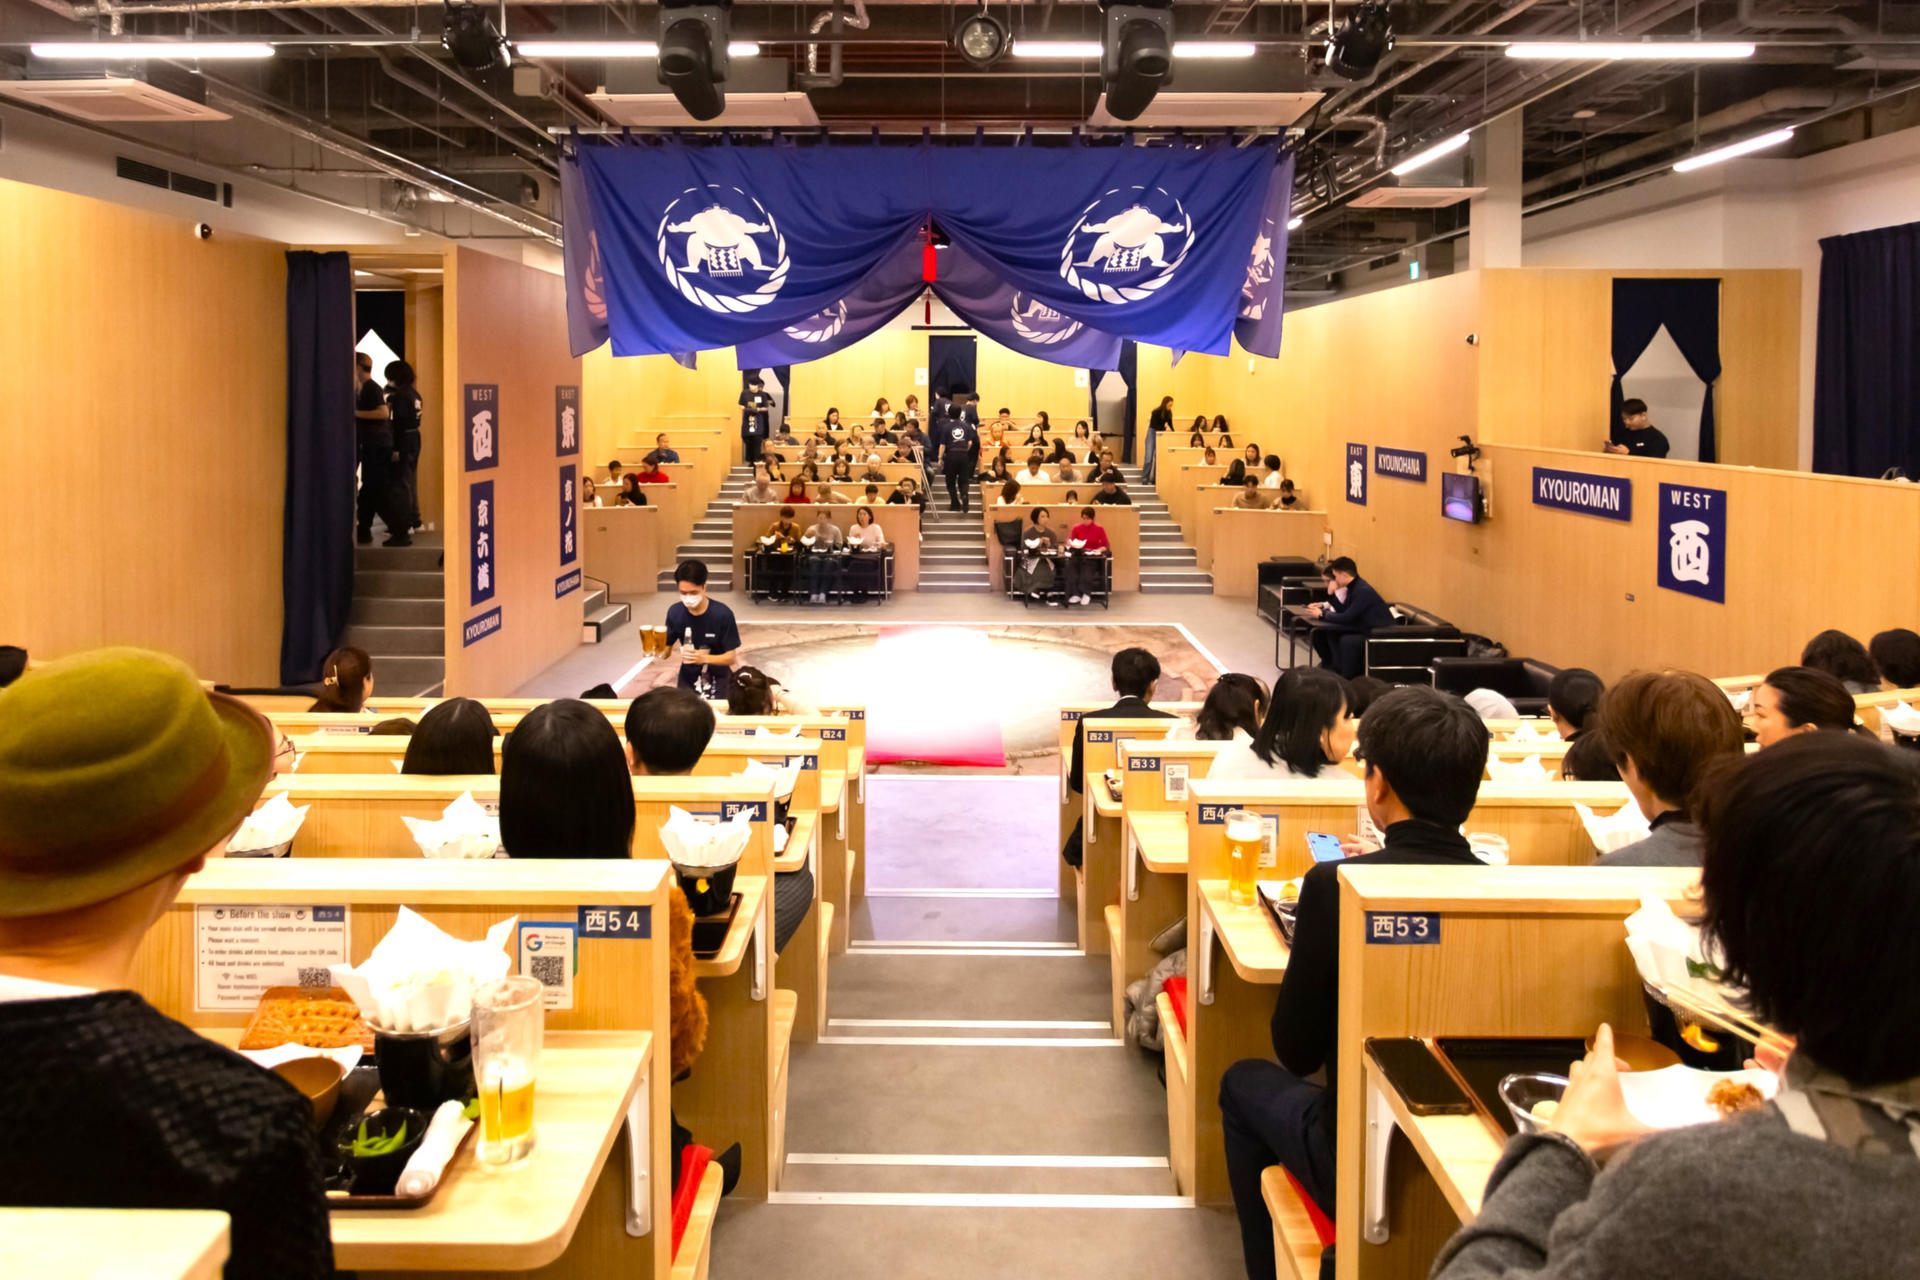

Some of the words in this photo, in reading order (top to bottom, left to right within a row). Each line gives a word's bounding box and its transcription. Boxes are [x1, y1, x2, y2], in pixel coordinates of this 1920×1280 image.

[472, 389, 492, 401] WEST
[561, 389, 575, 400] EAST
[1350, 446, 1363, 456] EAST
[1378, 453, 1420, 476] KYOUNOHANA
[1539, 477, 1620, 512] KYOUROMAN
[1671, 490, 1712, 510] WEST
[466, 613, 500, 642] KYOUROMAN
[822, 730, 843, 739] 西24
[1089, 732, 1109, 741] 西23
[1130, 758, 1157, 769] 西33
[230, 909, 254, 919] Before
[257, 909, 269, 919] the
[272, 909, 291, 919] show
[584, 910, 640, 932] 西54
[1372, 915, 1429, 938] 西53
